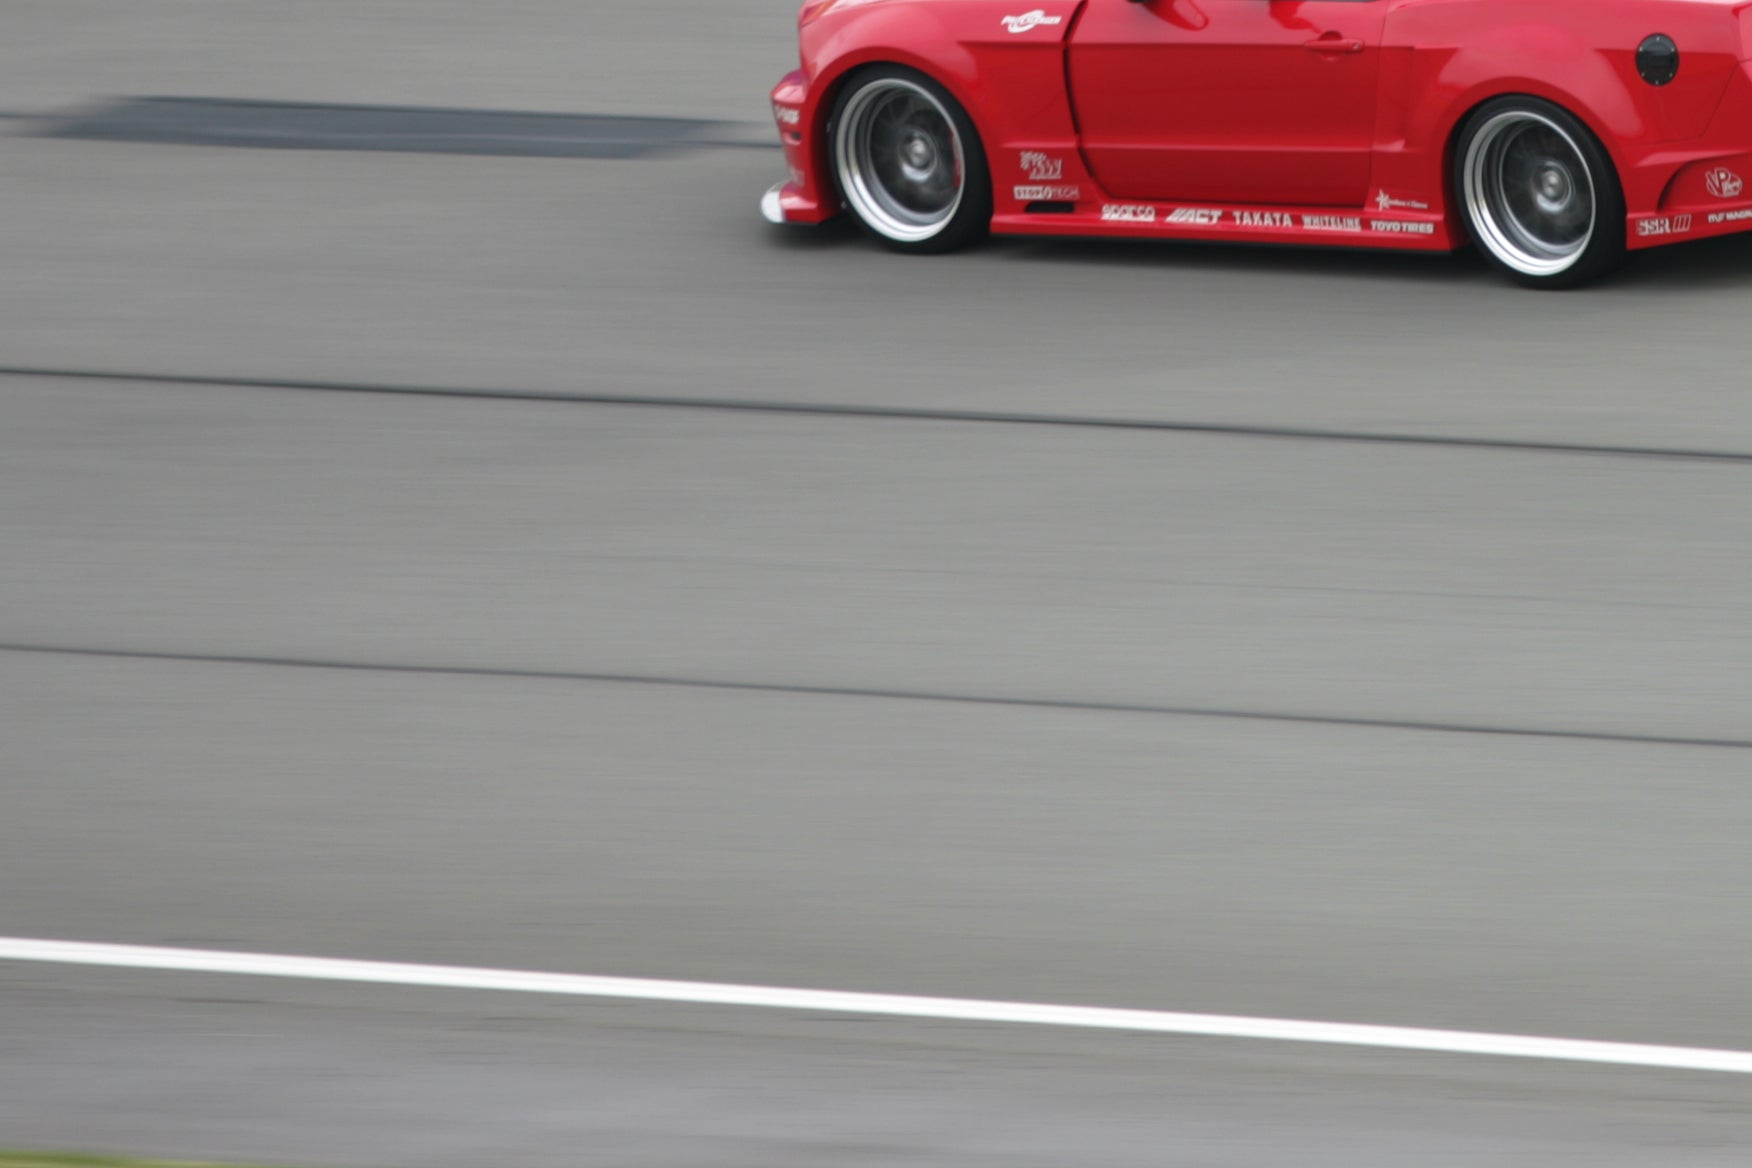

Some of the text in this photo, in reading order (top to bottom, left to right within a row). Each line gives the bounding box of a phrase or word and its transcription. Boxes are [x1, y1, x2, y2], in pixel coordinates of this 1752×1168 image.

[1232, 211, 1293, 227] TAKATA
[1301, 214, 1362, 232] WHITELINE
[1370, 220, 1435, 235] TOYO TIRES
[1636, 217, 1672, 236] SSR
